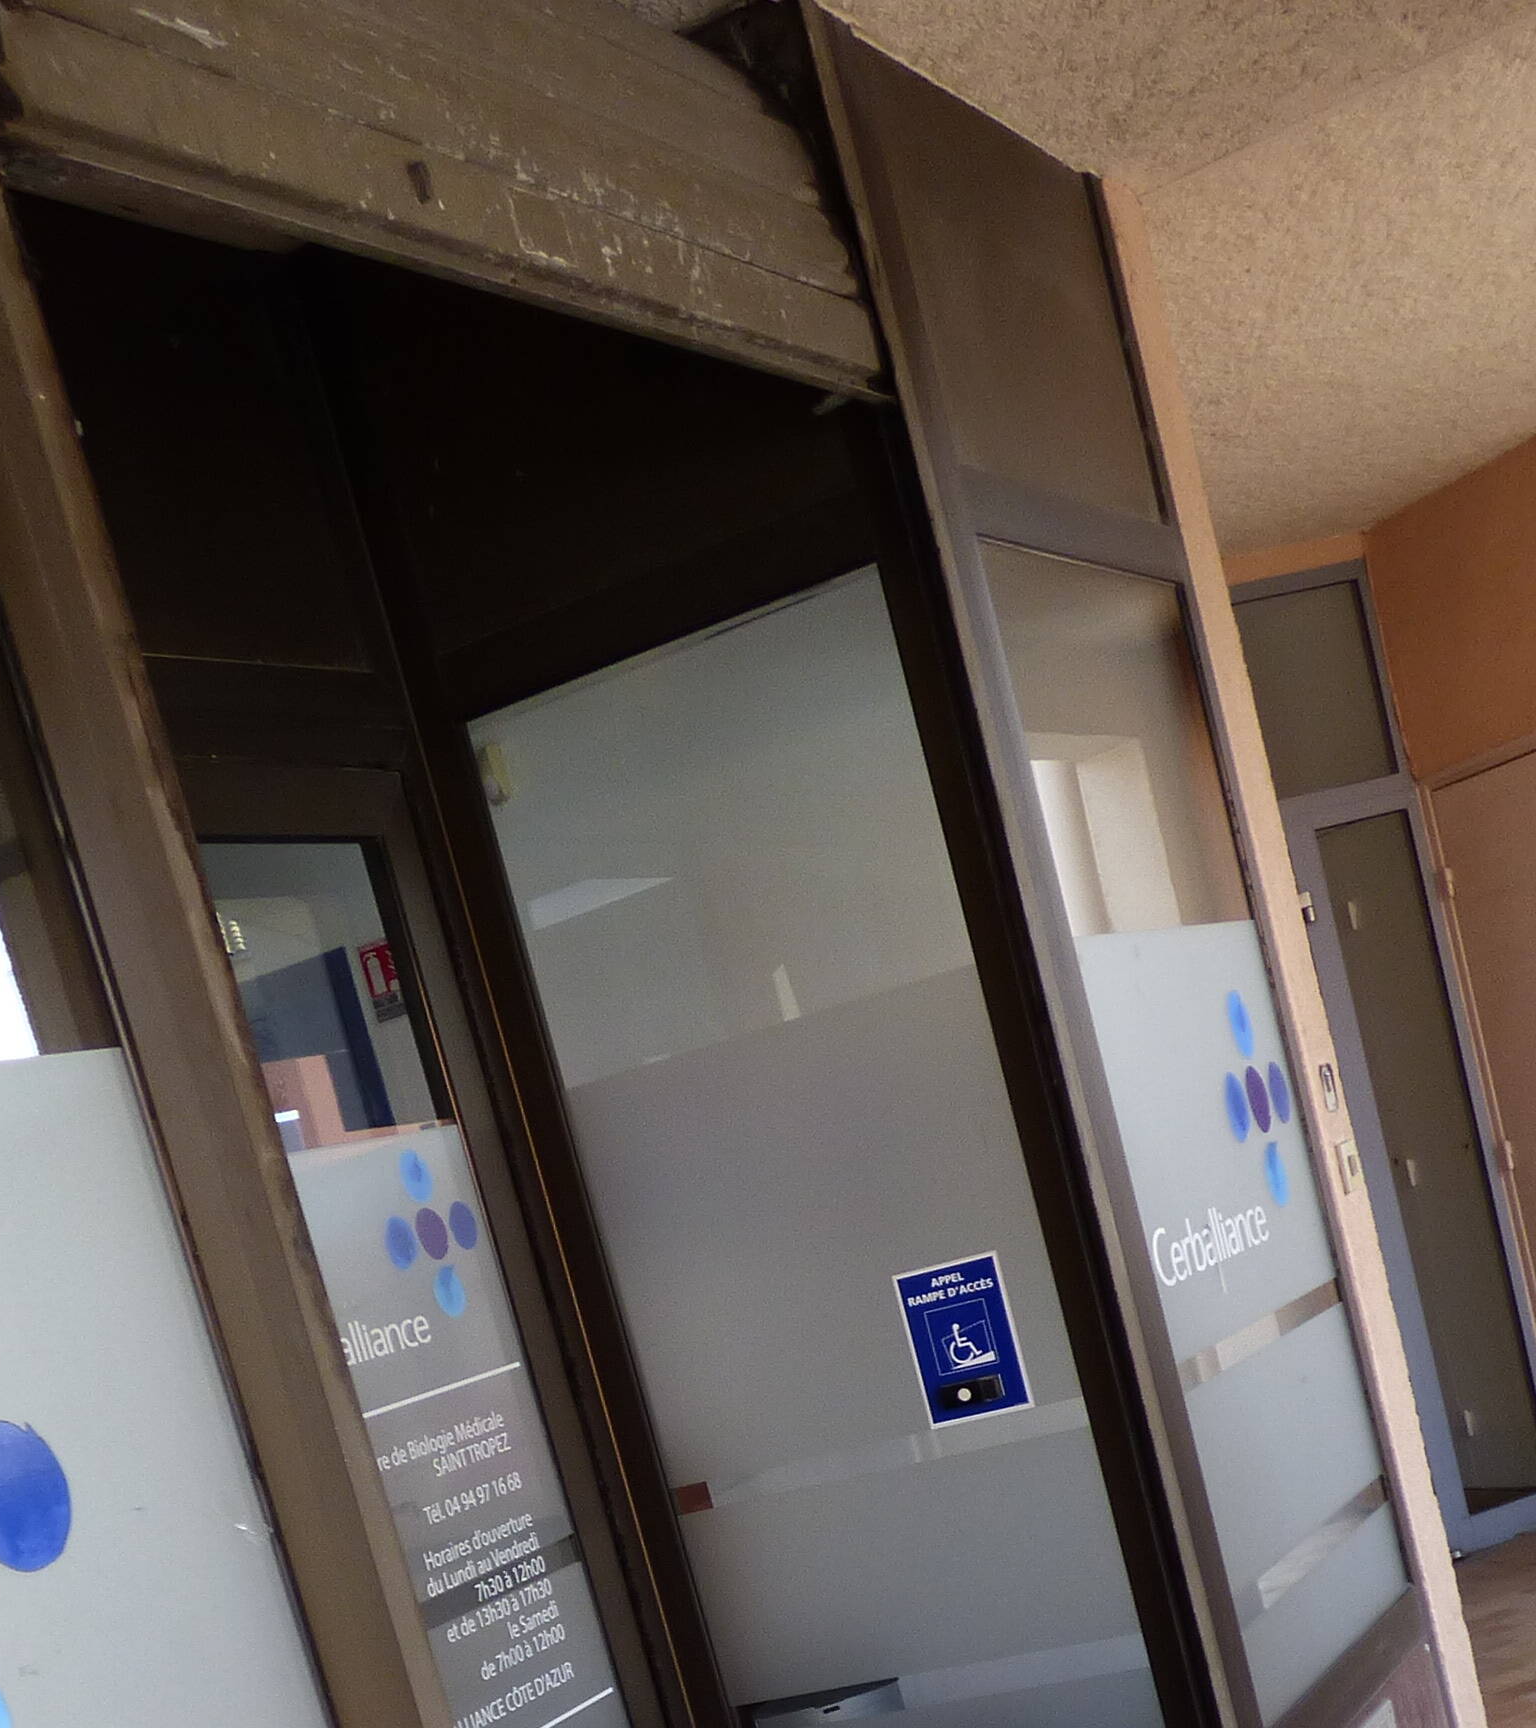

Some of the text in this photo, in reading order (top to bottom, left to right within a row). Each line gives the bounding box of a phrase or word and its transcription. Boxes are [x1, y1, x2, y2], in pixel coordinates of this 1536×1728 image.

[1152, 1206, 1270, 1288] Cerballiance
[907, 1277, 994, 1307] RAMPE D'ACCÈS
[931, 1272, 965, 1288] APPEL
[391, 1446, 408, 1466] de
[407, 1430, 455, 1460] Biologie
[454, 1411, 505, 1443] Médicale
[433, 1432, 512, 1477] SAINT TROPEZ
[445, 1495, 461, 1517] 04
[460, 1489, 478, 1511] 94
[476, 1483, 491, 1504] 97
[492, 1477, 507, 1497] 16
[507, 1471, 522, 1491] 68
[422, 1513, 533, 1571] Horaires d'ouverture
[427, 1532, 541, 1598] du Lundi au Vendredi
[474, 1555, 546, 1602] 7h30 à 12h00
[446, 1578, 553, 1643] et de 13h30 à 17h30
[506, 1600, 560, 1640] le Samedi
[480, 1623, 565, 1680] de 7h00 à 12h00
[505, 1682, 536, 1711] CÔTE
[533, 1662, 575, 1696] D'AZUR
